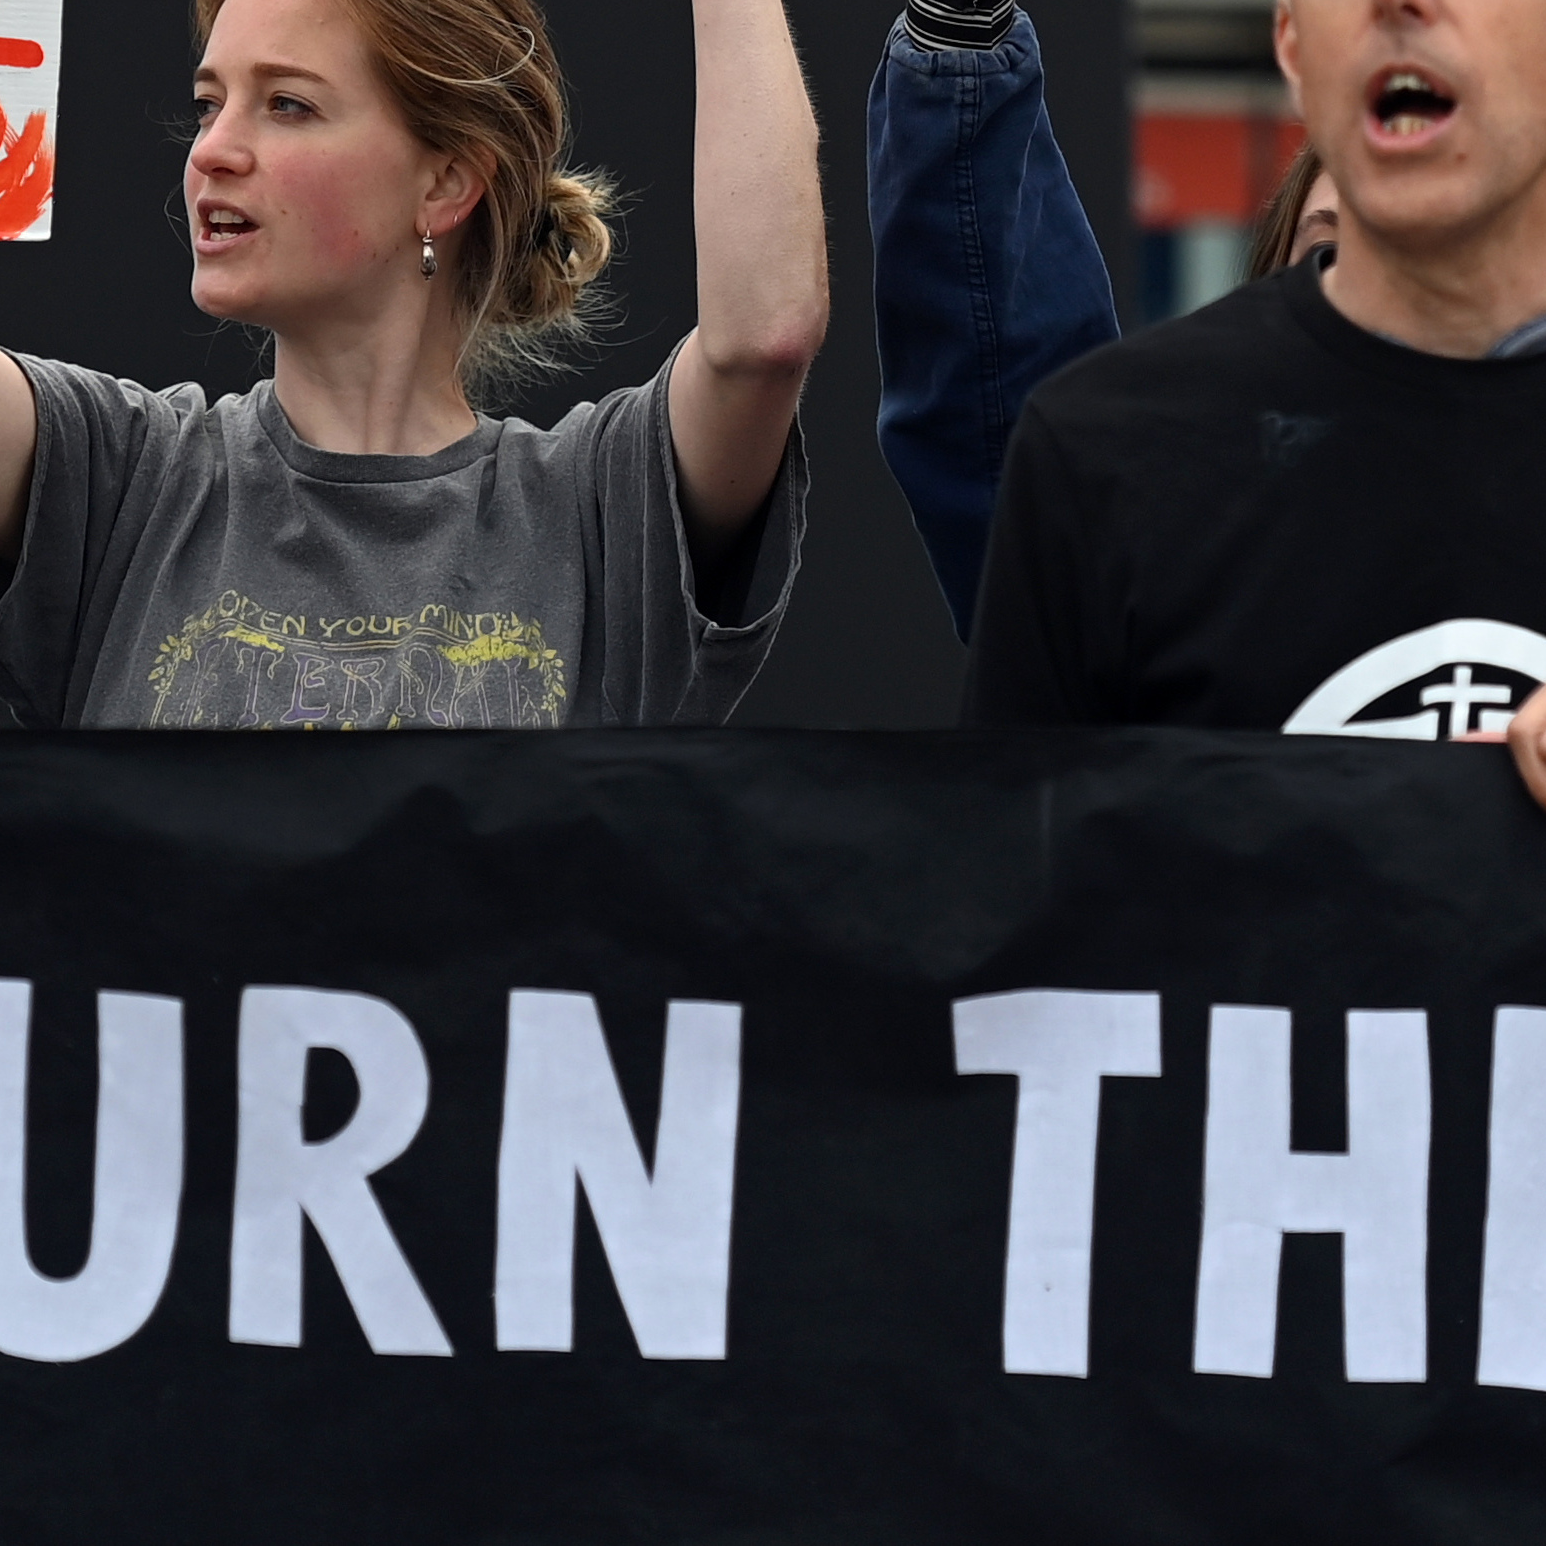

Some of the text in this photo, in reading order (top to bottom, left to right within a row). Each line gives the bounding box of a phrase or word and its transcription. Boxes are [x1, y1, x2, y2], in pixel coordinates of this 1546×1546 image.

[219, 590, 501, 639] OPEN YOUR MIND
